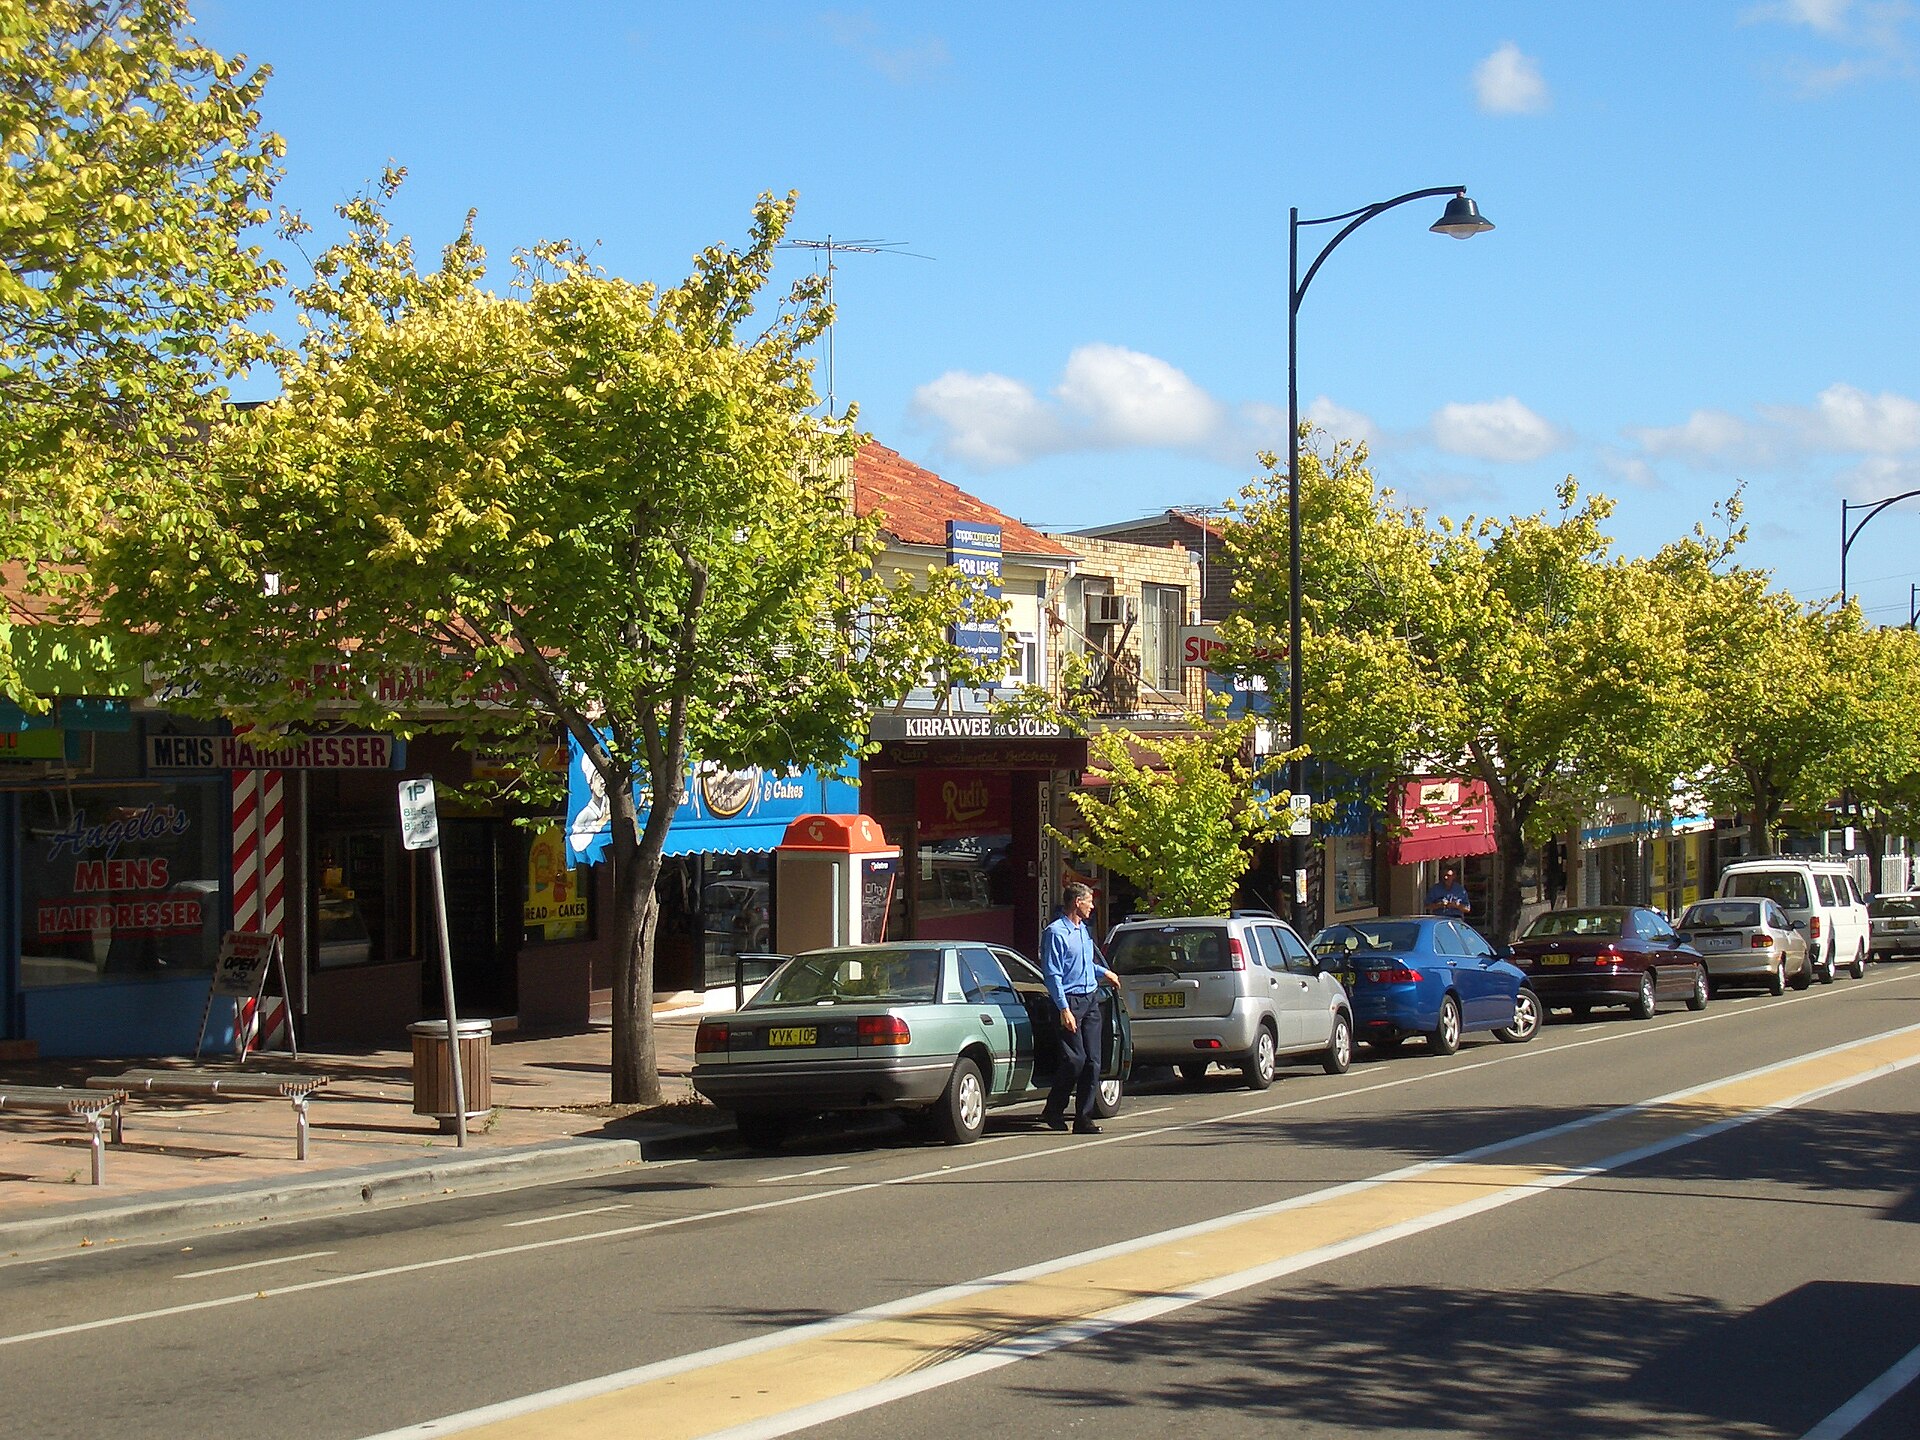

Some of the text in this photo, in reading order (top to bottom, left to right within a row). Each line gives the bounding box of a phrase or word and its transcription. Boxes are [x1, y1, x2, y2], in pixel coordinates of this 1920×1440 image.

[959, 559, 999, 577] FOR LEASE
[905, 717, 1060, 736] KIRRAWEE CYCLES
[153, 737, 387, 767] MENS HAIRDRESSER
[407, 785, 426, 801] 1P
[764, 780, 804, 802] & Cakes
[1294, 797, 1307, 807] 1P
[48, 802, 191, 861] Angelo's
[1040, 786, 1049, 933] CHIROPRACTO
[73, 858, 169, 893] MENS
[38, 901, 203, 934] HAIRDRESSER
[558, 903, 586, 917] CAKES
[224, 956, 262, 971] OPEN
